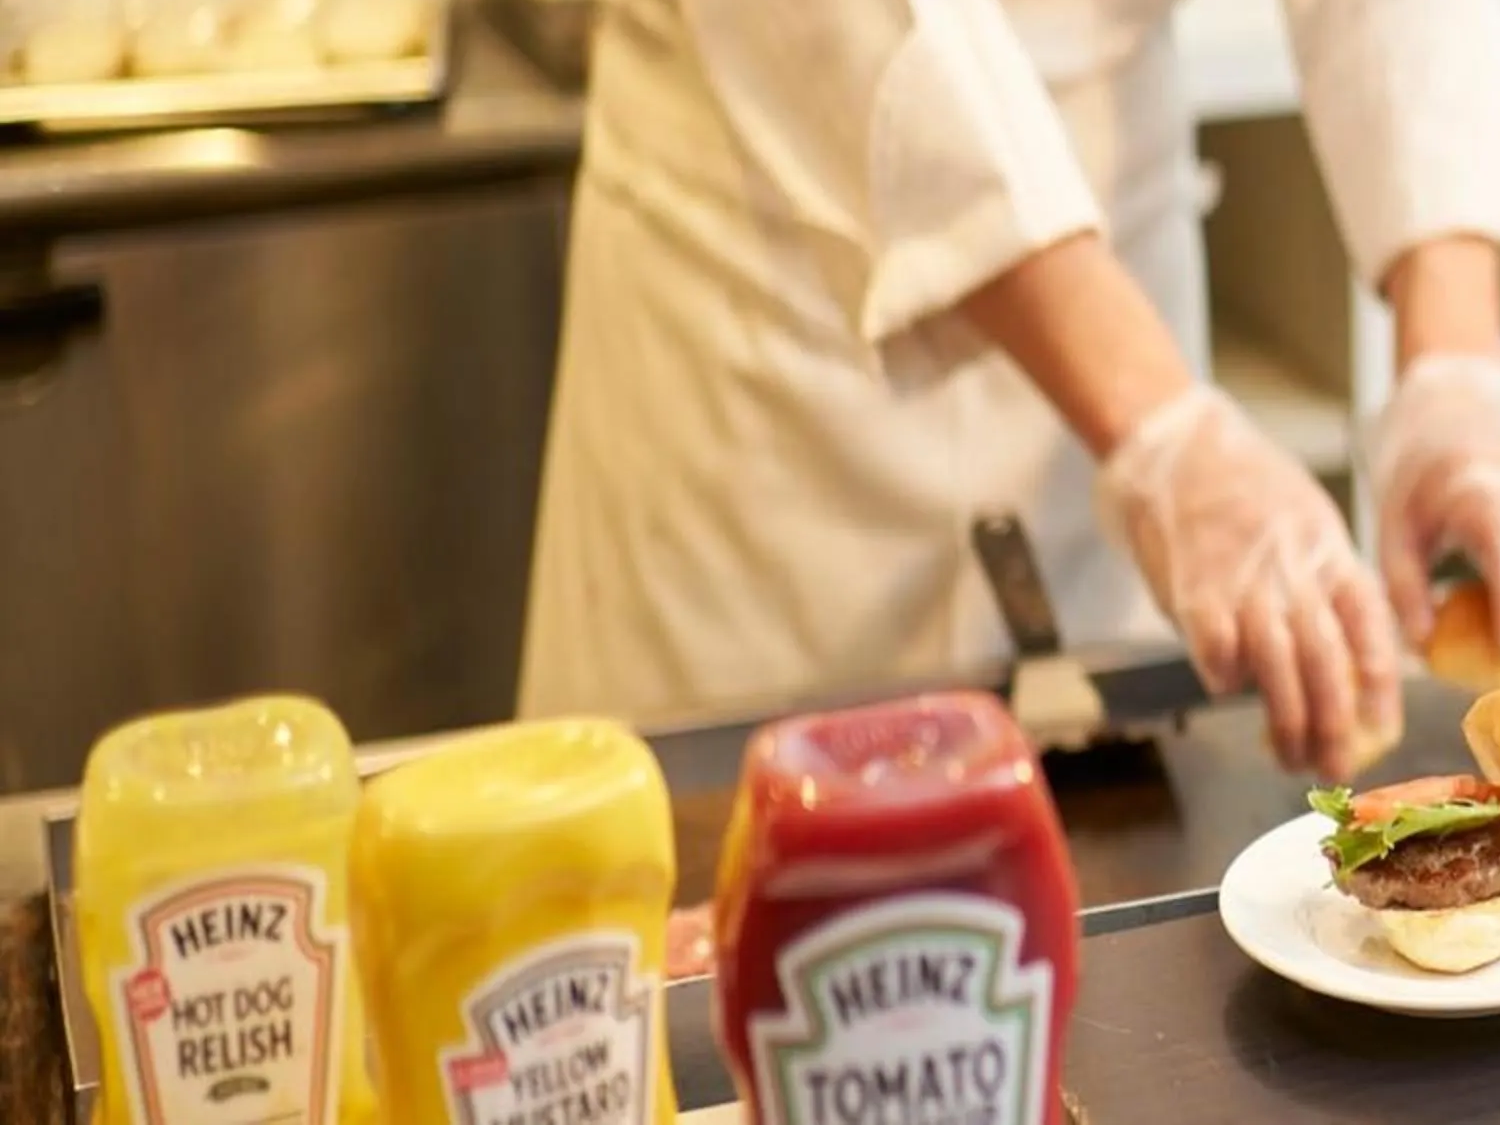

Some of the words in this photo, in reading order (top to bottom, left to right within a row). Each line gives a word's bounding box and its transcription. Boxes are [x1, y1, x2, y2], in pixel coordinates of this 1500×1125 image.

[170, 902, 288, 959] HEINZ
[172, 989, 226, 1032] HOT
[233, 976, 294, 1020] DOG
[503, 972, 609, 1044] HEINZ
[830, 951, 976, 1025] HEINZ
[178, 1019, 294, 1079] RELISH
[807, 1037, 1006, 1125] TOMATO
